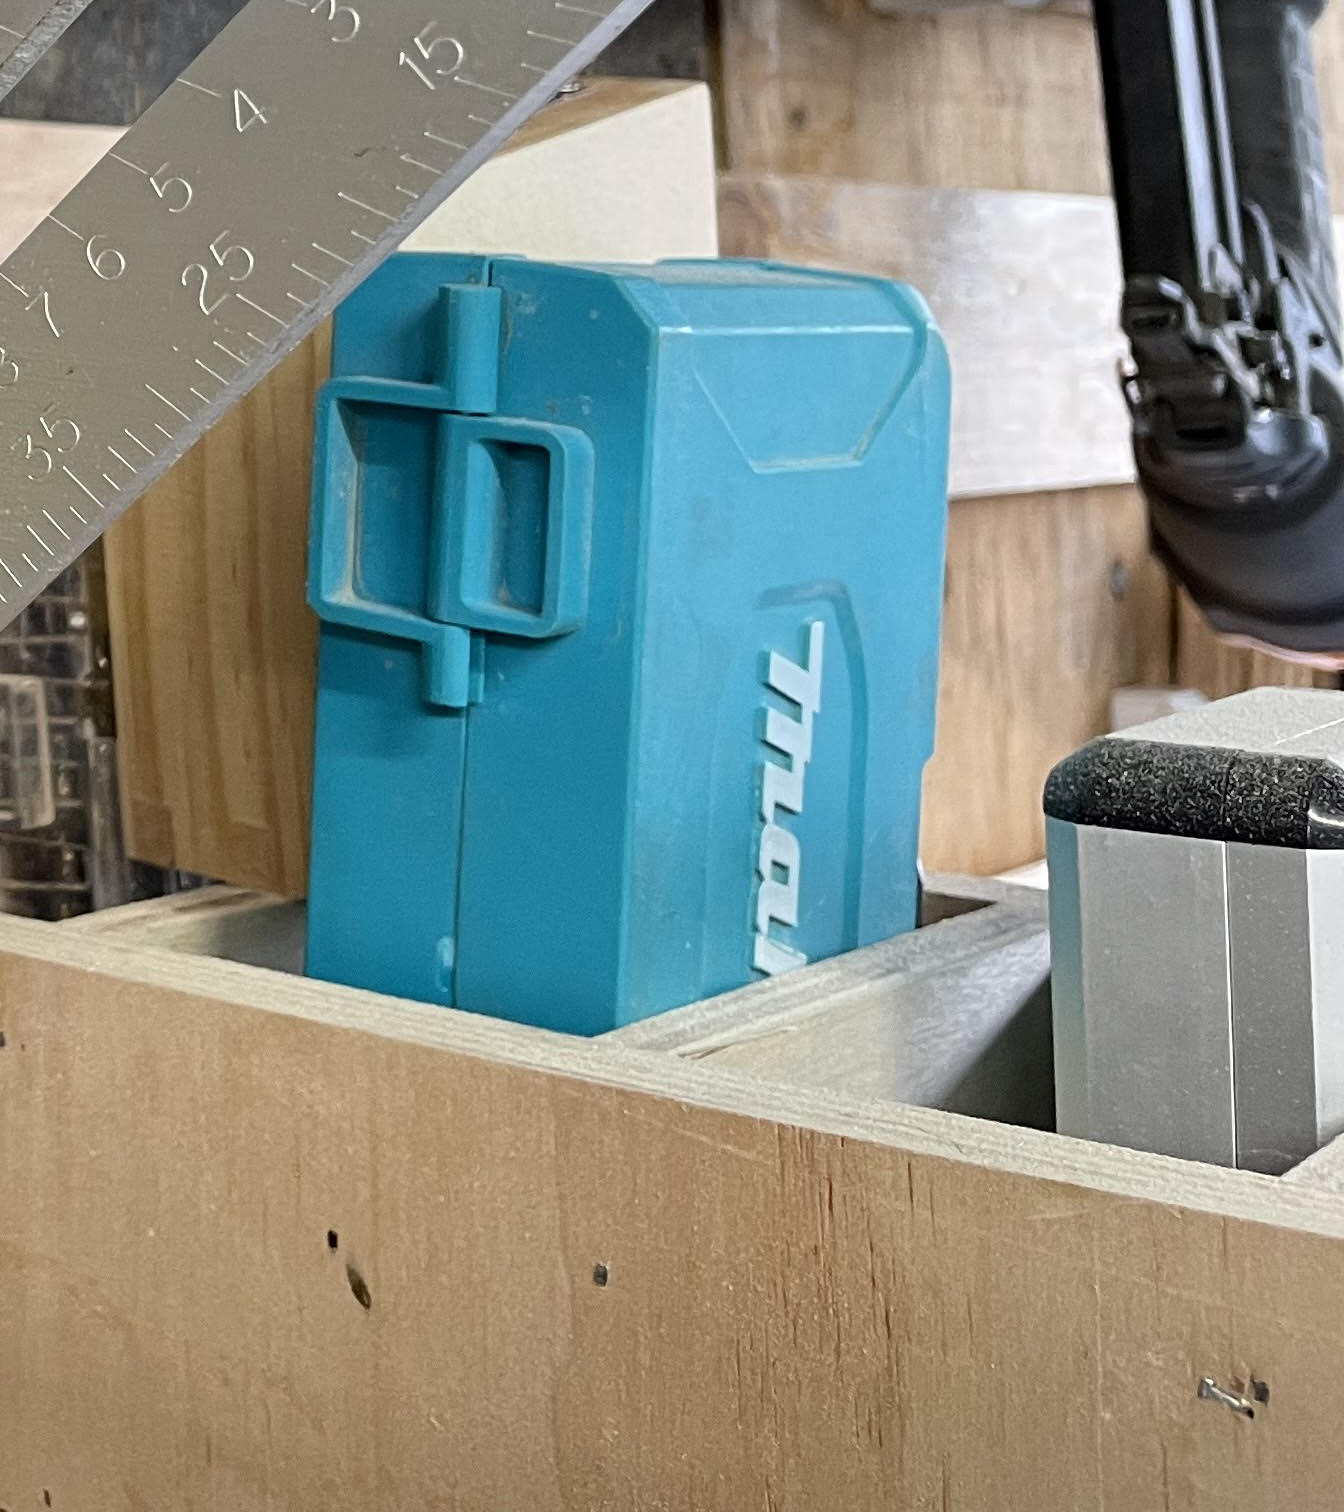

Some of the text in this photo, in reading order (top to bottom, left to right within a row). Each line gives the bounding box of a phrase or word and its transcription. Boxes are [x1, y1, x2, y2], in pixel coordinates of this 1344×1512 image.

[399, 20, 465, 90] 15
[233, 88, 269, 134] 4
[149, 161, 194, 213] 5
[86, 233, 127, 281] 6
[182, 228, 255, 316] 25
[24, 288, 62, 339] 7
[10, 400, 82, 482] 35
